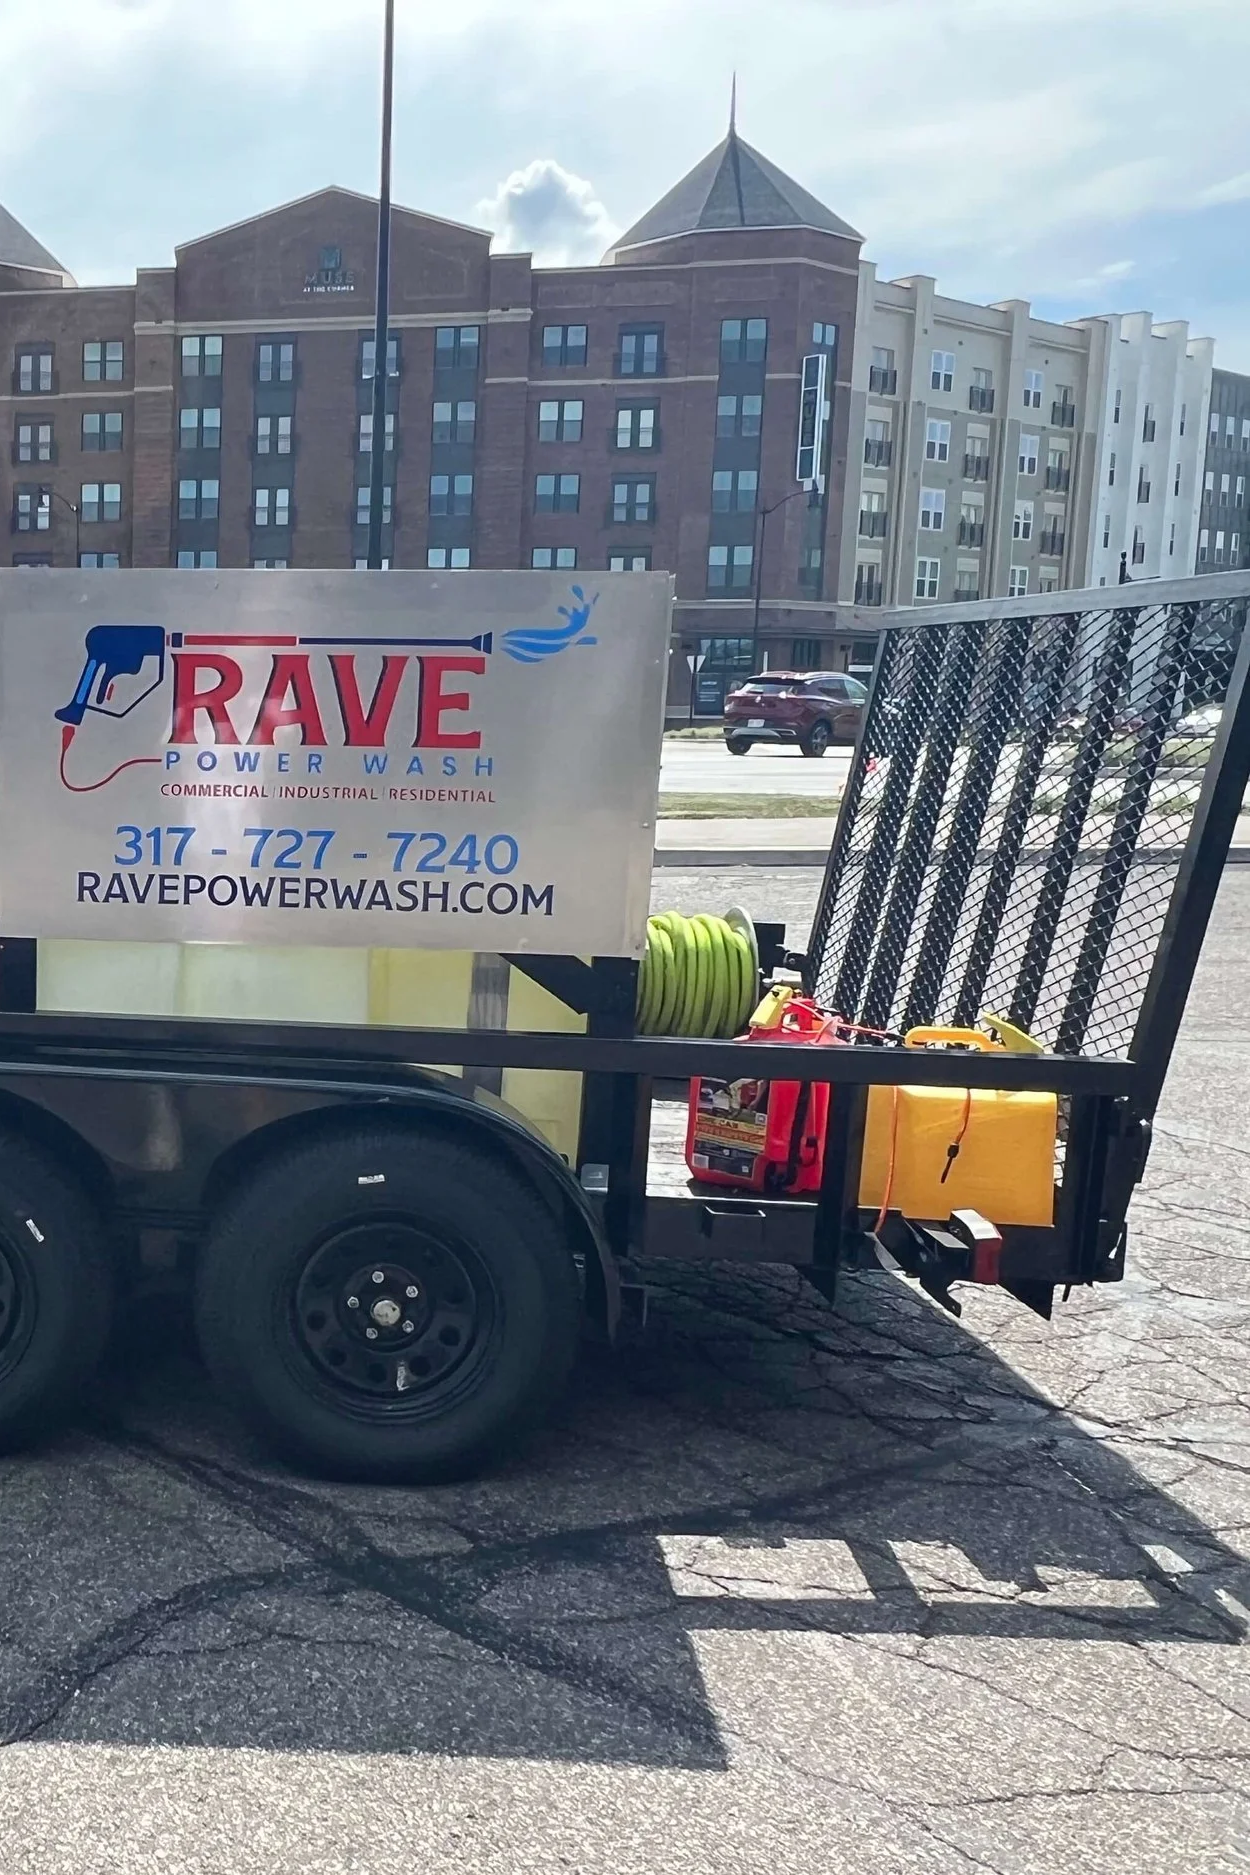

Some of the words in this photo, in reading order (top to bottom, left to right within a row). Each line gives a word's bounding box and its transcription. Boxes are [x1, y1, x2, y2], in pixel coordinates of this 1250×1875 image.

[168, 653, 486, 749] RAVE
[166, 751, 323, 773] POWER
[364, 753, 494, 776] WASH
[161, 783, 269, 798] COMMERCIAL
[279, 786, 379, 800] INDUSTRIAL
[389, 787, 496, 803] RESIDENTIAL
[114, 825, 196, 866] 317
[243, 827, 336, 871] 727
[387, 831, 519, 876] 7240
[77, 871, 554, 916] RAVEPOWERWASH.COM
